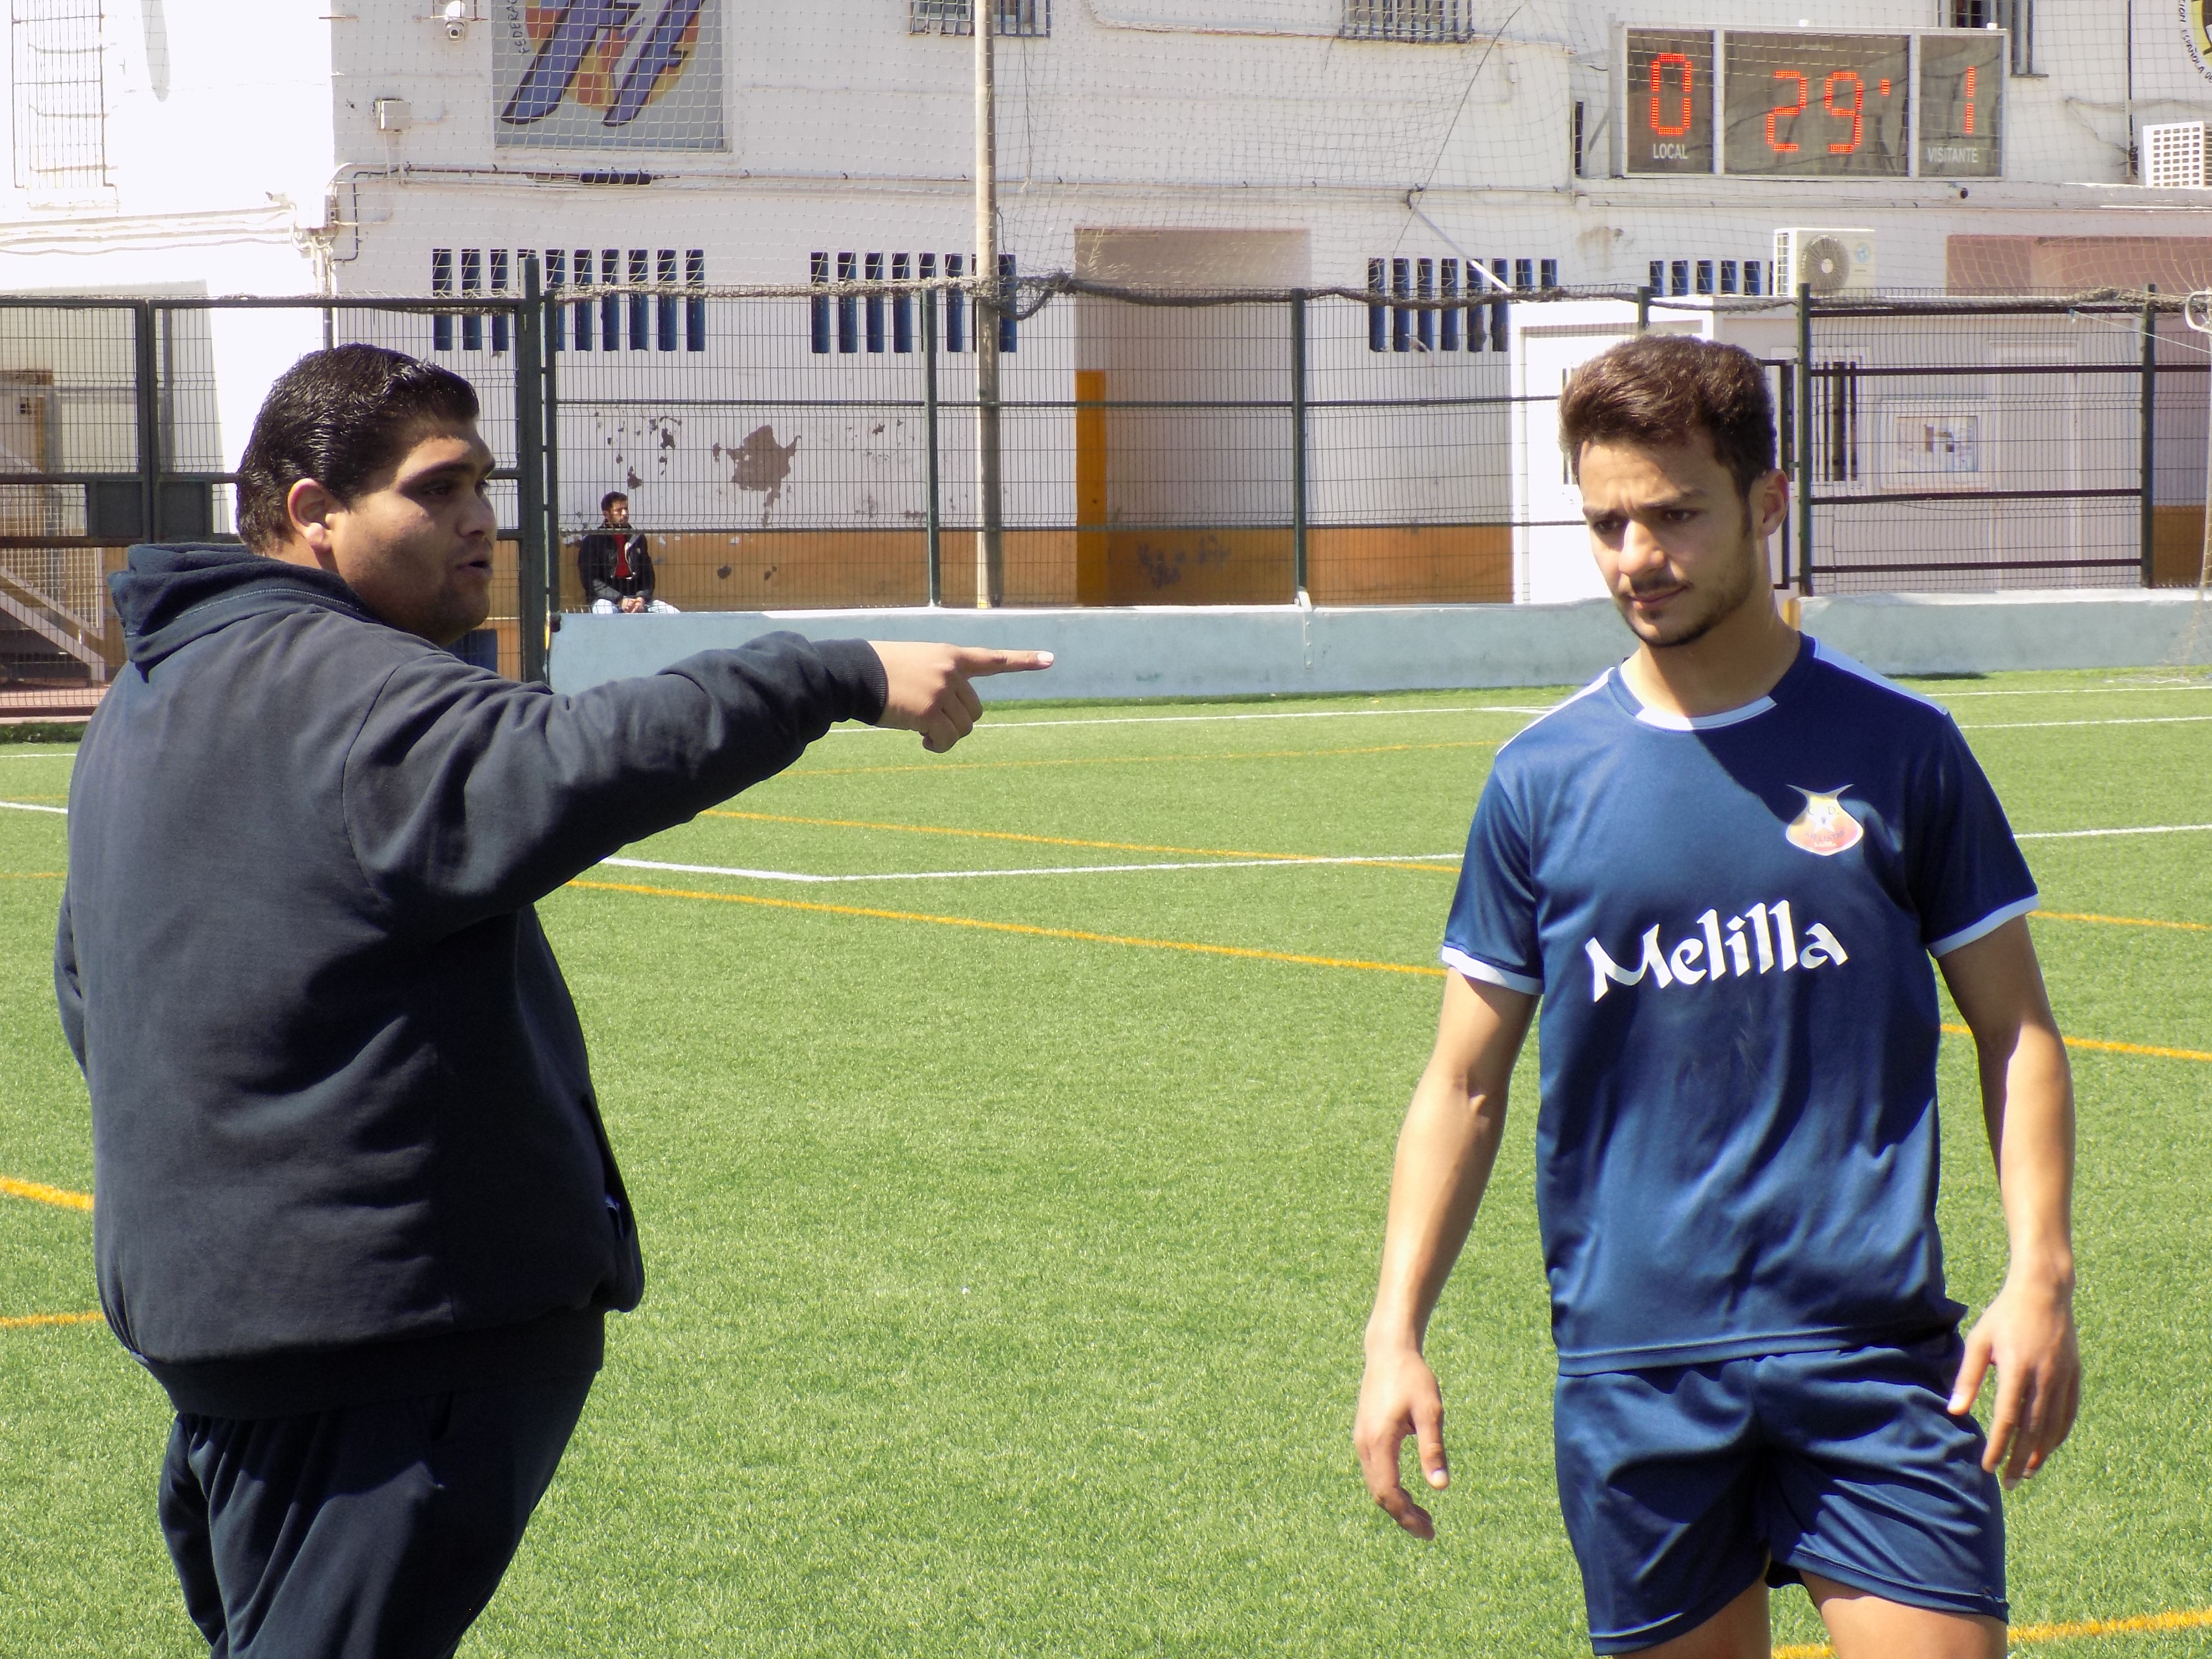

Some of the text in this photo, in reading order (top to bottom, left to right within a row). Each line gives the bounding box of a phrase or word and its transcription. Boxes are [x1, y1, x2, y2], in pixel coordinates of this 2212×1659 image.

[1651, 53, 1691, 136] 0
[1966, 66, 1975, 134] 1
[1653, 143, 1689, 159] LOCAL
[1927, 147, 1978, 163] VISITANTE
[1585, 899, 1849, 1003] Melilla
